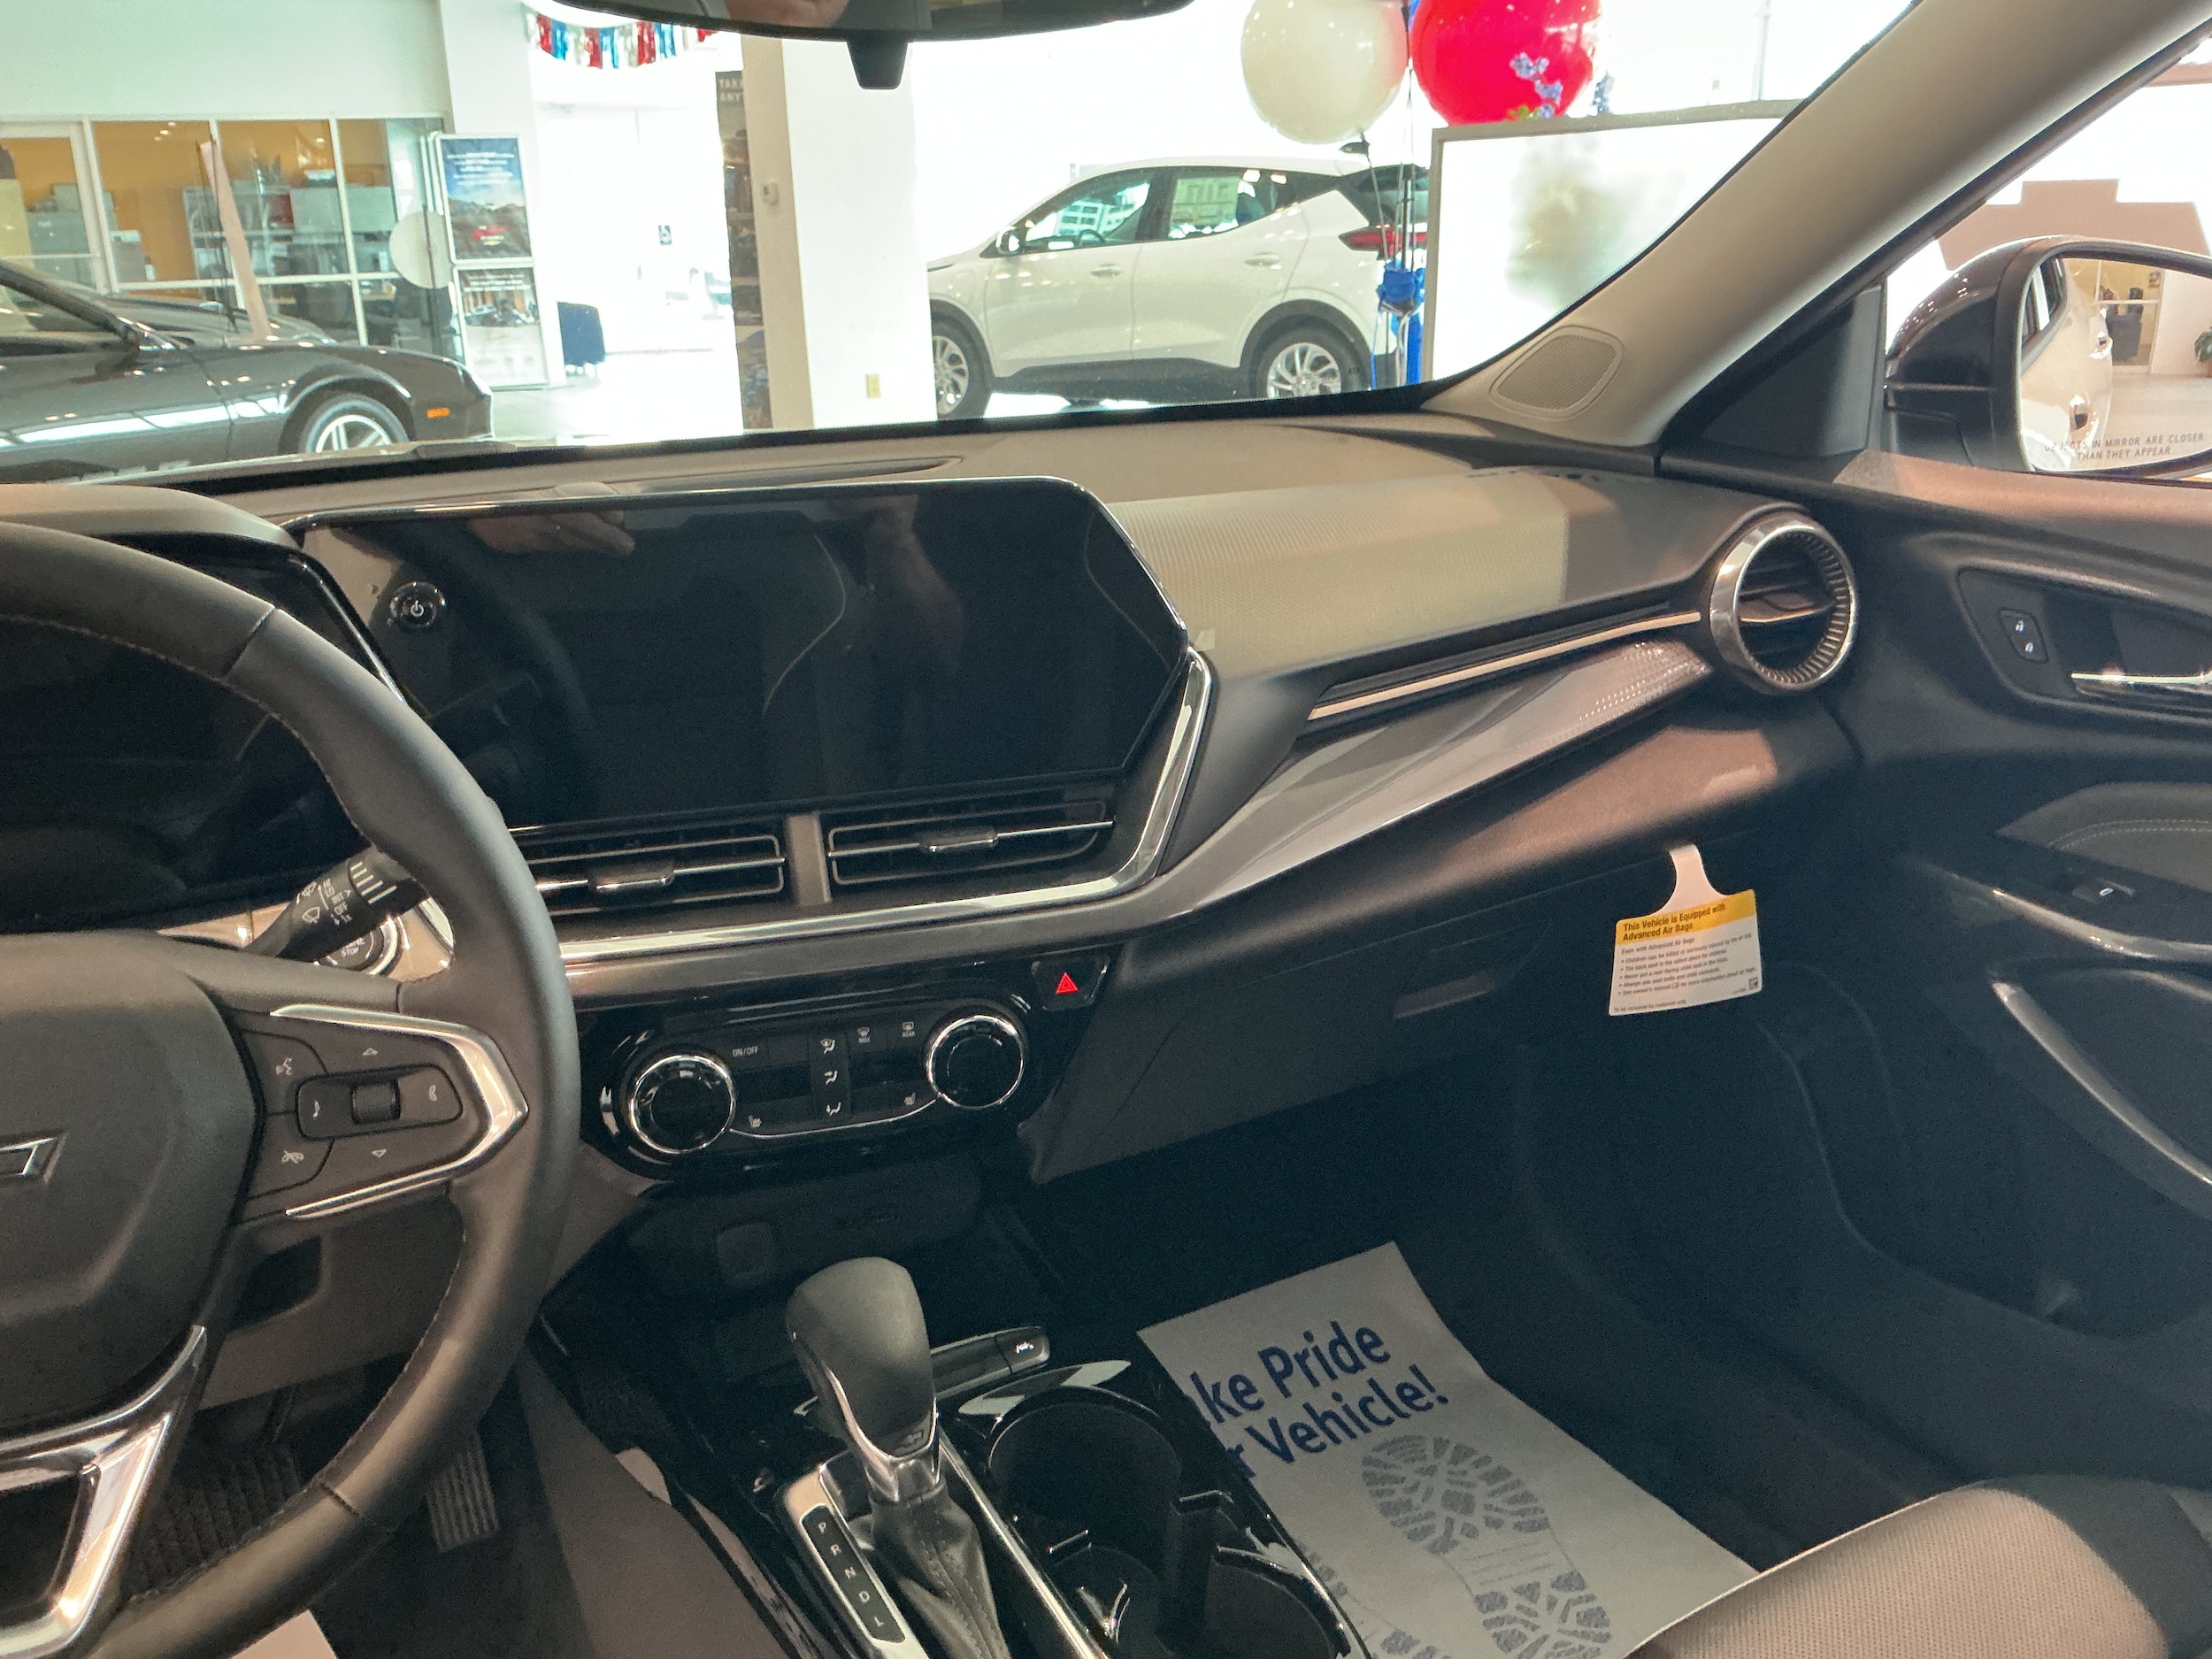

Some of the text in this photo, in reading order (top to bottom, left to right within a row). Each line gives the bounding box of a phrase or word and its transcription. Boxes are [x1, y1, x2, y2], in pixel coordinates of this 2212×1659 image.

[2093, 439, 2101, 448] IN
[2105, 436, 2140, 447] MIRROR
[2146, 434, 2163, 444] ARE
[2169, 432, 2204, 443] CLOSER
[2078, 446, 2171, 461] THAN THEY APPEAR
[1624, 921, 1640, 932] This
[1642, 917, 1669, 928] Vehicle
[1679, 907, 1710, 922] Equipped
[1712, 902, 1725, 913] with
[1623, 922, 1694, 941] Advanced Air Bags
[341, 947, 359, 956] STOP
[732, 1046, 759, 1057] ON/OFF
[1190, 1320, 1391, 1424] ke Pride
[1244, 1363, 1449, 1464] Vehicle!
[818, 1521, 827, 1534] P
[830, 1543, 842, 1555] R
[844, 1566, 856, 1580] N
[858, 1591, 871, 1603] D
[874, 1616, 884, 1627] L
